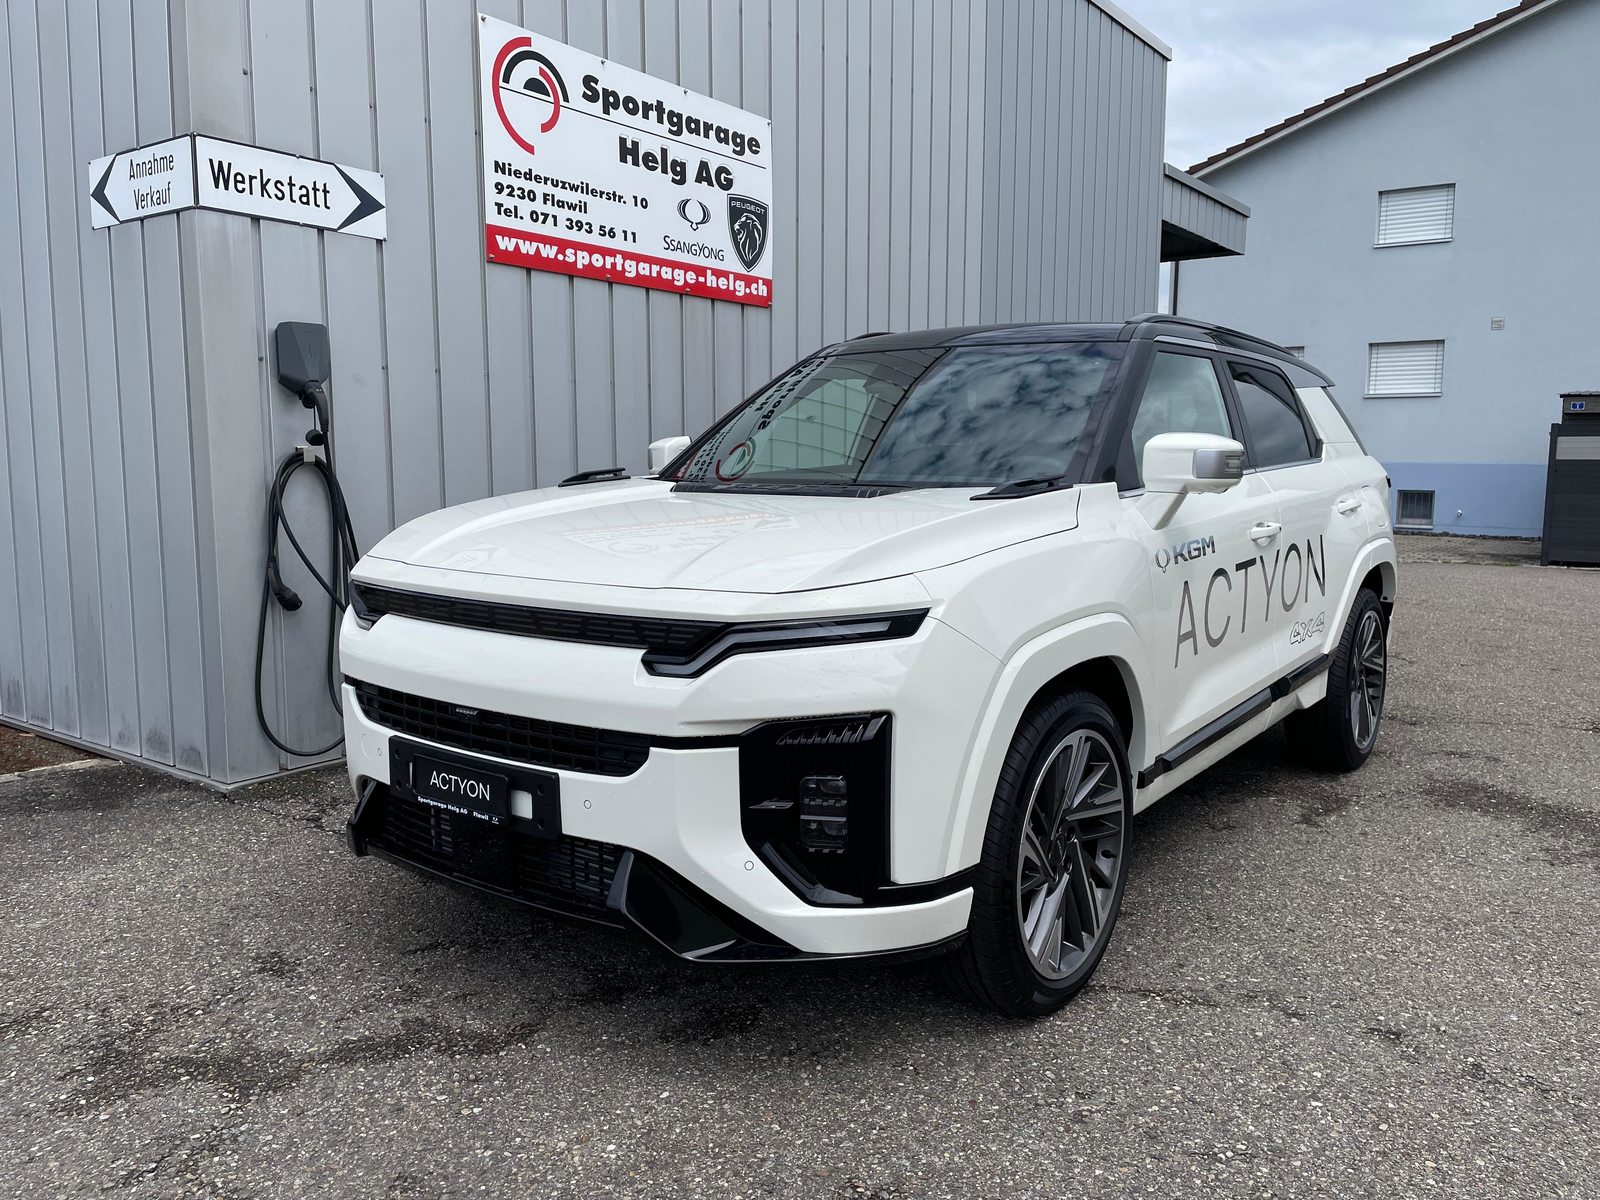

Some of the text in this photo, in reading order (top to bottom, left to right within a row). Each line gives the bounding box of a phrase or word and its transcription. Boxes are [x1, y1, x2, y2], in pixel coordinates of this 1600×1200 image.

[582, 74, 761, 156] Sportgarage
[129, 153, 174, 181] Annahme
[618, 134, 734, 191] Helg AG
[134, 181, 171, 211] Verkauf
[209, 158, 331, 210] Werkstatt
[494, 160, 649, 210] Niederuzwilerstr. 10
[494, 182, 588, 214] 9230 Flawil
[494, 202, 637, 243] Tel. 071 393 56 11
[730, 200, 766, 215] PEUGEOT
[495, 234, 768, 297] www.sportgarage-helg.ch
[1173, 535, 1216, 565] KGM
[1174, 534, 1326, 669] ACTYON
[430, 770, 490, 801] ACTYON
[417, 796, 447, 809] Sportgarage
[447, 804, 460, 813] Helg
